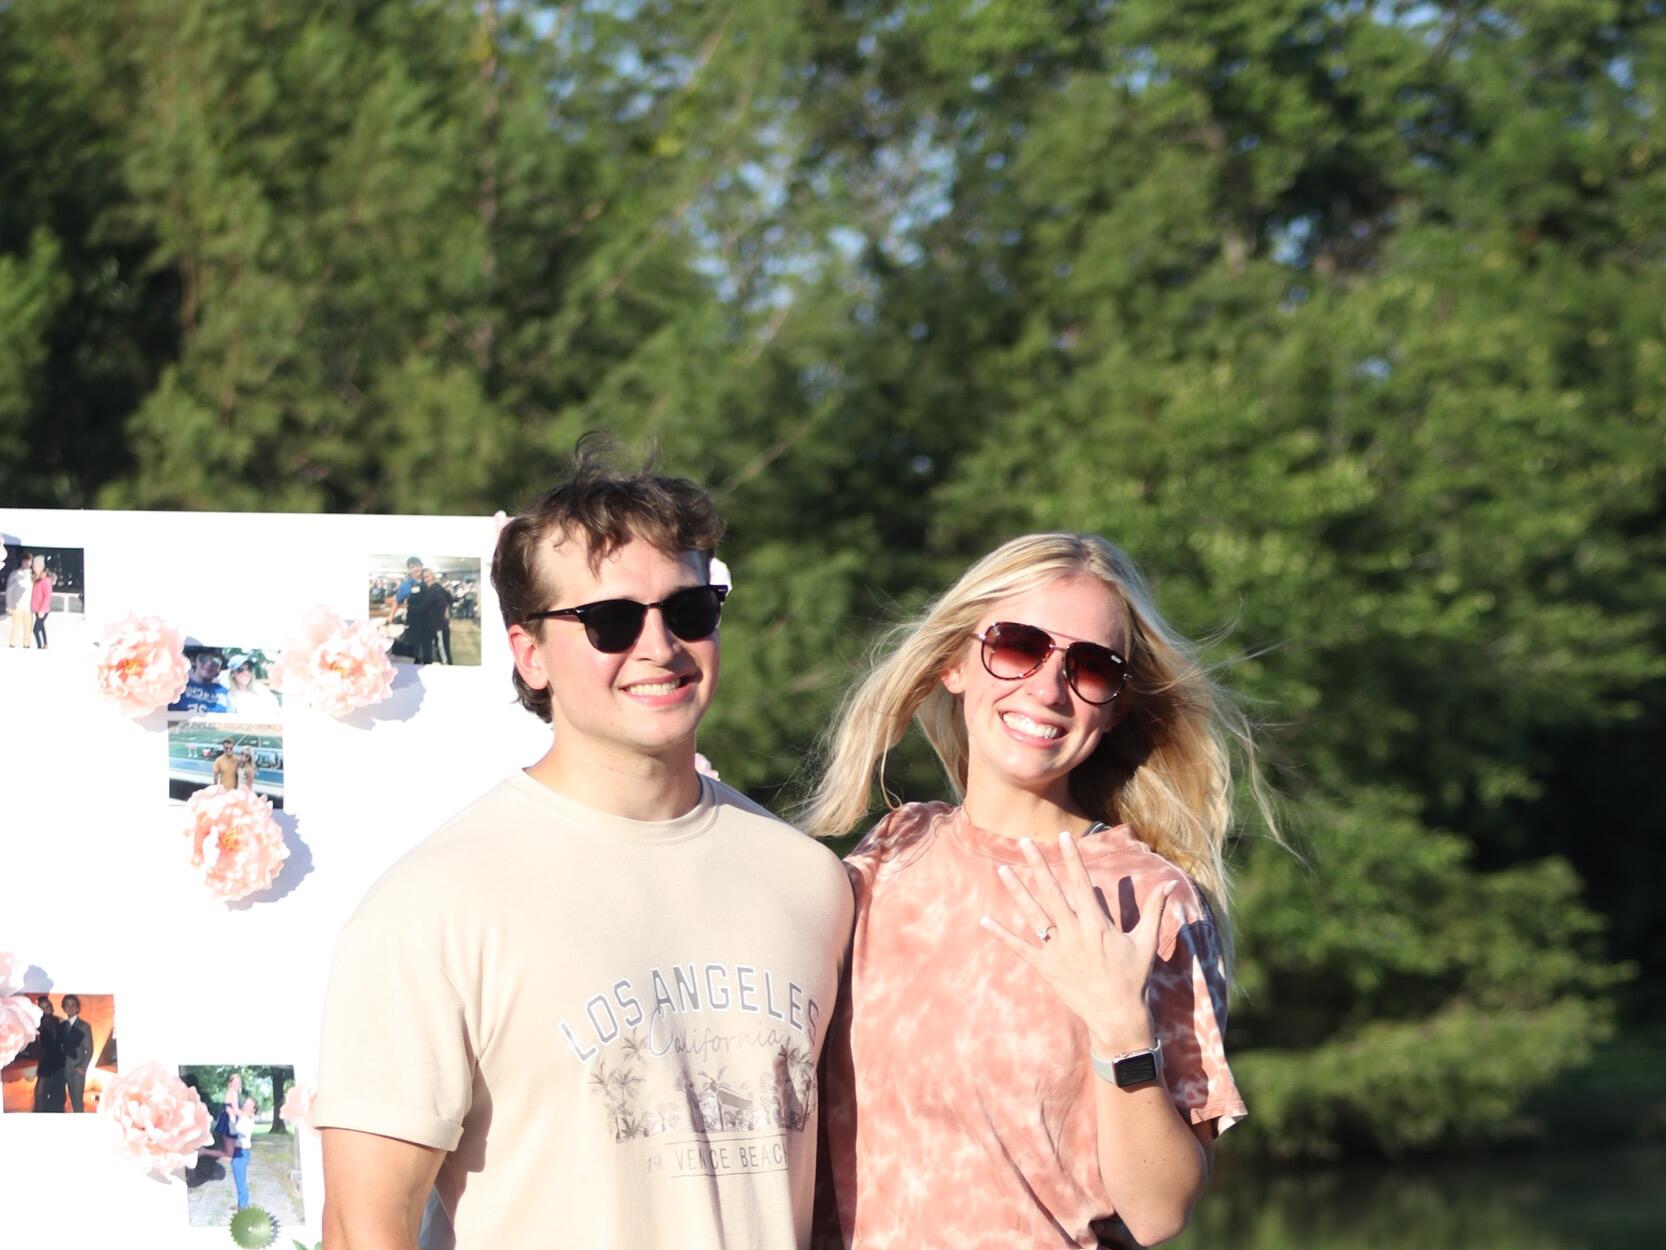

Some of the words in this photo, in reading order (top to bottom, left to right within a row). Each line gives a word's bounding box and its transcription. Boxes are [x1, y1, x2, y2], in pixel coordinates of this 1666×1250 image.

[559, 977, 644, 1063] LOS
[650, 963, 819, 1047] ANGELES
[649, 1004, 783, 1061] California
[674, 1147, 731, 1171] VENCE
[739, 1142, 788, 1168] BEAC
